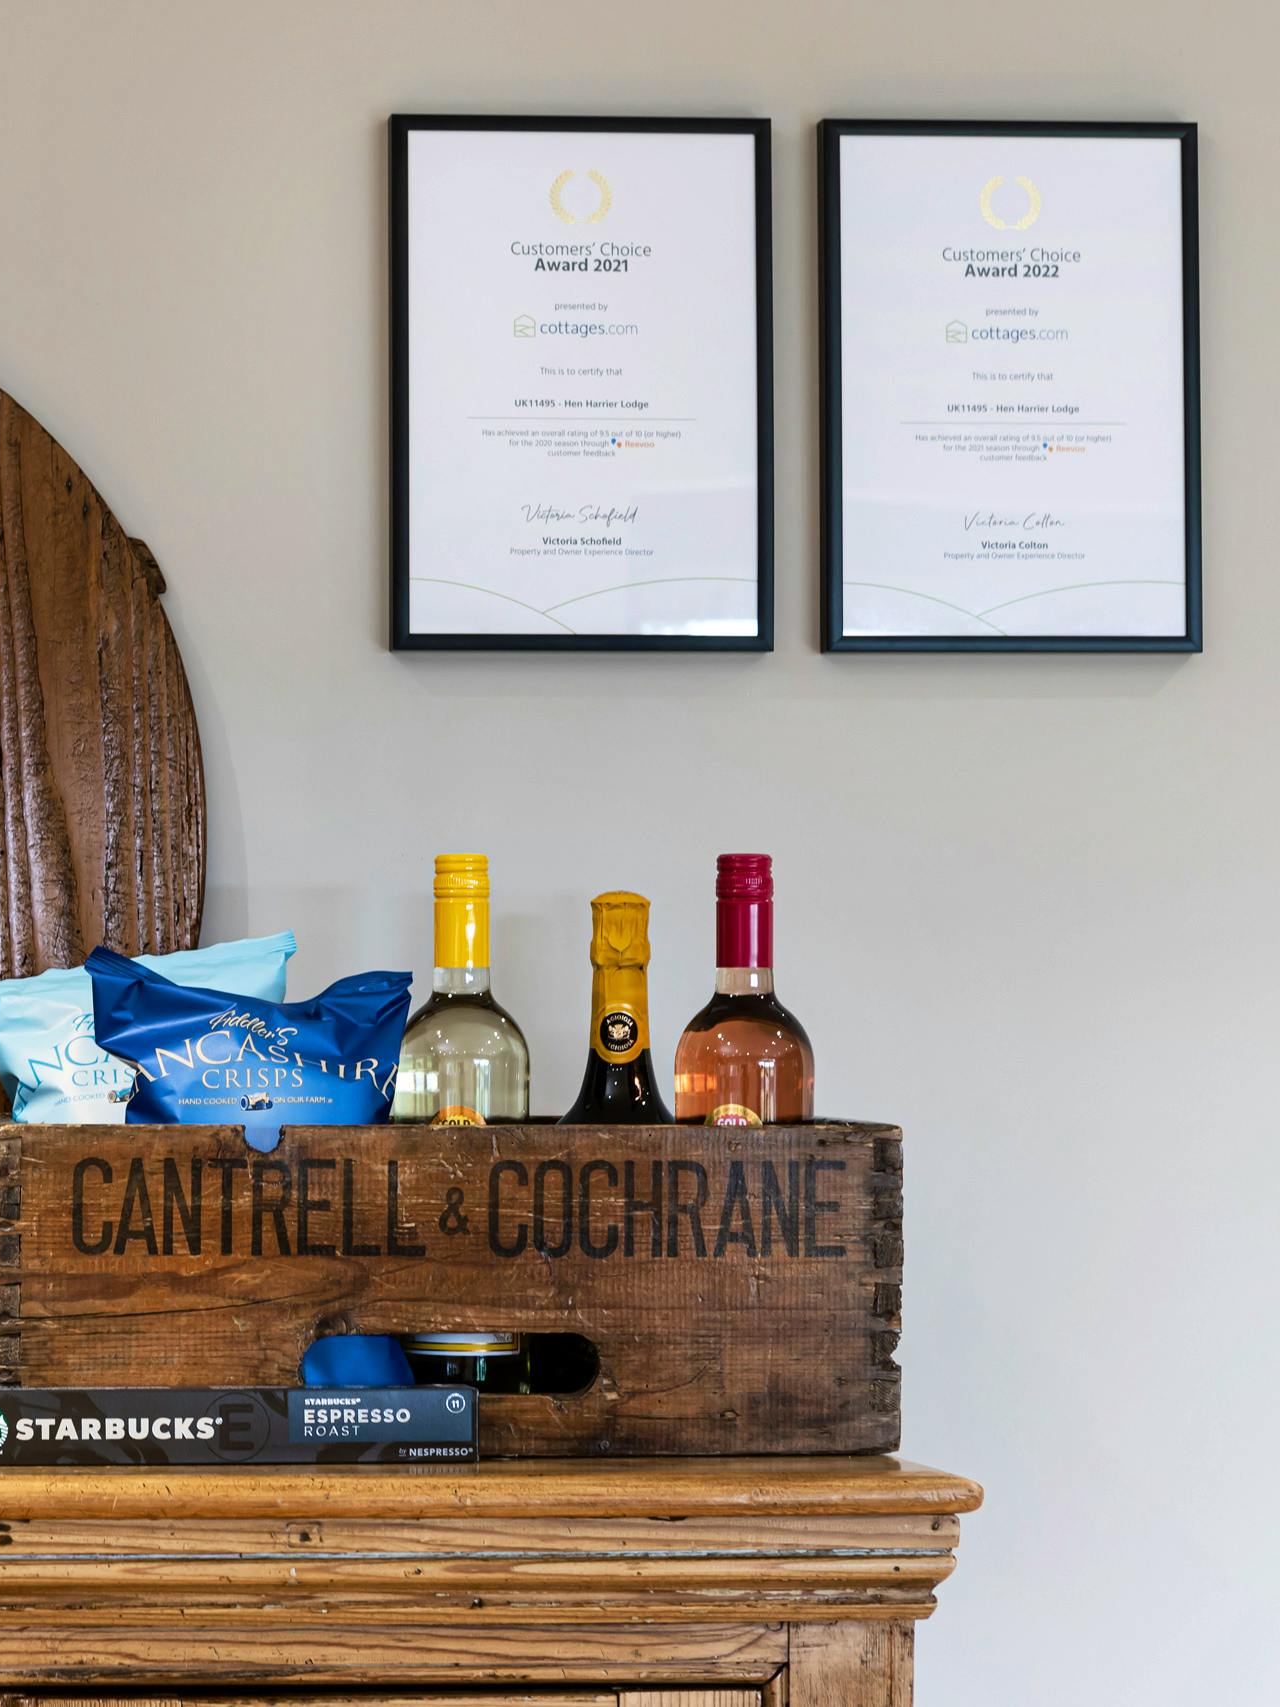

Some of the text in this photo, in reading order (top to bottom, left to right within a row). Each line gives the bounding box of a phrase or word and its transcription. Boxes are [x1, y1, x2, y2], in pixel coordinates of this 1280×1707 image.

[511, 242, 651, 257] Customers' Choice
[943, 248, 1080, 262] Customers' Choice
[535, 258, 627, 272] Award 2021
[965, 263, 1059, 278] Award 2022
[555, 303, 608, 312] presented by
[986, 307, 1039, 317] presented by
[540, 321, 637, 338] cottages.com
[972, 327, 1068, 343] cottages.com
[541, 367, 556, 375] This
[578, 368, 603, 377] certify
[606, 368, 622, 376] that
[973, 372, 988, 380] This
[1009, 372, 1035, 382] certify
[1037, 372, 1053, 381] that
[565, 400, 582, 408] Hen
[586, 400, 618, 408] Harrier
[621, 400, 648, 410] Lodge
[948, 404, 1079, 415] UK11495 Hen Harrier Lodge
[590, 429, 598, 438] of
[625, 429, 633, 438] of
[543, 537, 621, 545] Victoria Schofield
[981, 541, 1048, 549] Victoria Colton
[510, 547, 541, 556] Property
[625, 548, 655, 556] Director
[72, 1069, 135, 1088] CRIS
[202, 1068, 304, 1089] CRISPS
[179, 1097, 202, 1105] HAND
[204, 1097, 237, 1105] COOKED
[273, 1096, 287, 1104] ON
[288, 1096, 304, 1104] OUR
[305, 1096, 326, 1104] FARM
[72, 1158, 848, 1259] CANTRELL & COCHRANE
[451, 1400, 460, 1409] 11
[304, 1408, 411, 1424] ESPRESSO
[304, 1425, 360, 1437] ROAST
[399, 1447, 407, 1457] by
